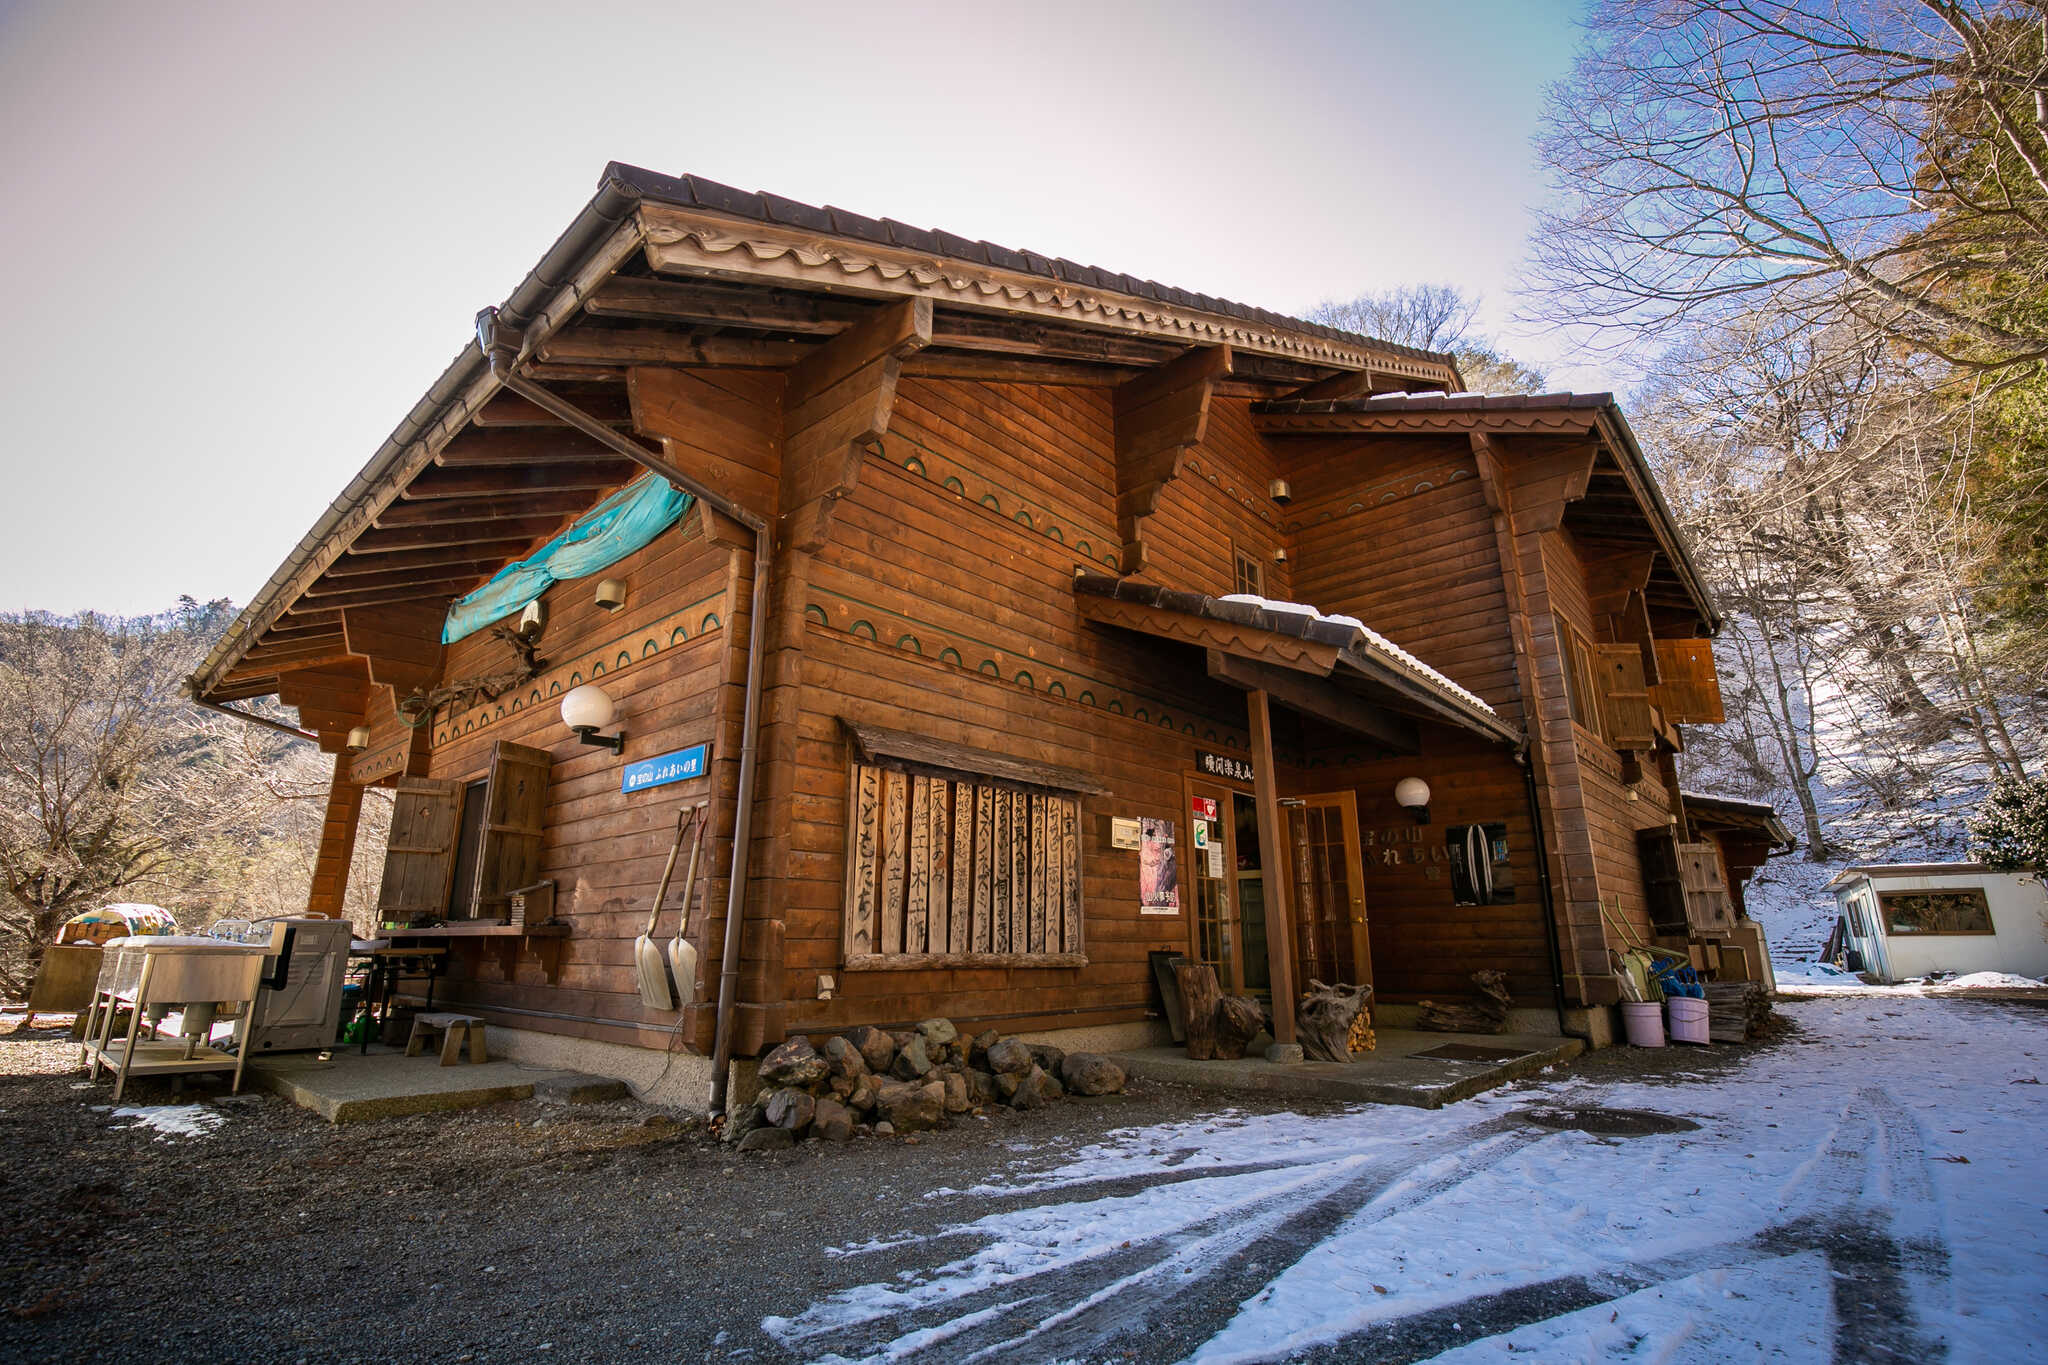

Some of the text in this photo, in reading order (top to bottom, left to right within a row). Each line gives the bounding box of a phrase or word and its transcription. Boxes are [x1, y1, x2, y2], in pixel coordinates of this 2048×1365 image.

[654, 758, 697, 780] ふれあいの里
[854, 775, 878, 946] こどもたちへ
